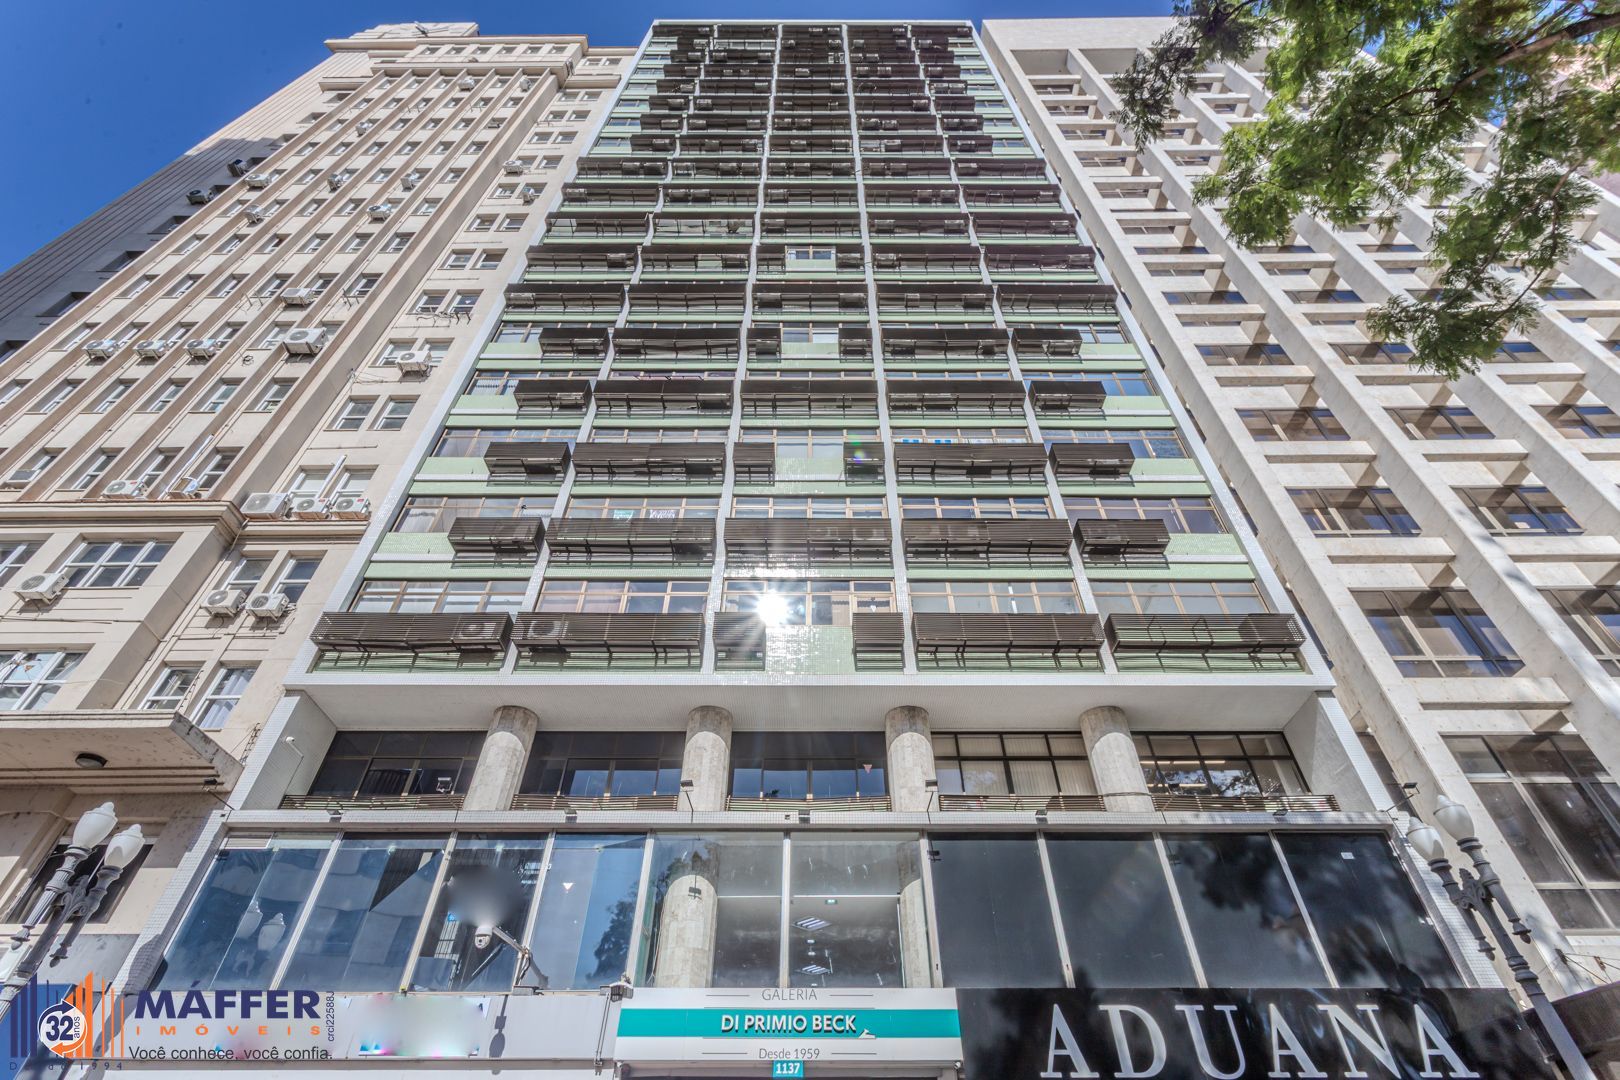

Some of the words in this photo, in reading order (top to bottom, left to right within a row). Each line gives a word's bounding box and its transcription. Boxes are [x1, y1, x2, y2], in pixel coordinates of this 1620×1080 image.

[761, 988, 818, 1001] GALERIA
[721, 1015, 739, 1032] DI
[744, 1015, 807, 1033] PRIMIO
[812, 1014, 857, 1033] BECK
[1039, 1003, 1480, 1080] ADUANA
[759, 1048, 790, 1059] Desde
[793, 1048, 820, 1060] 1959
[775, 1063, 801, 1074] 1137
